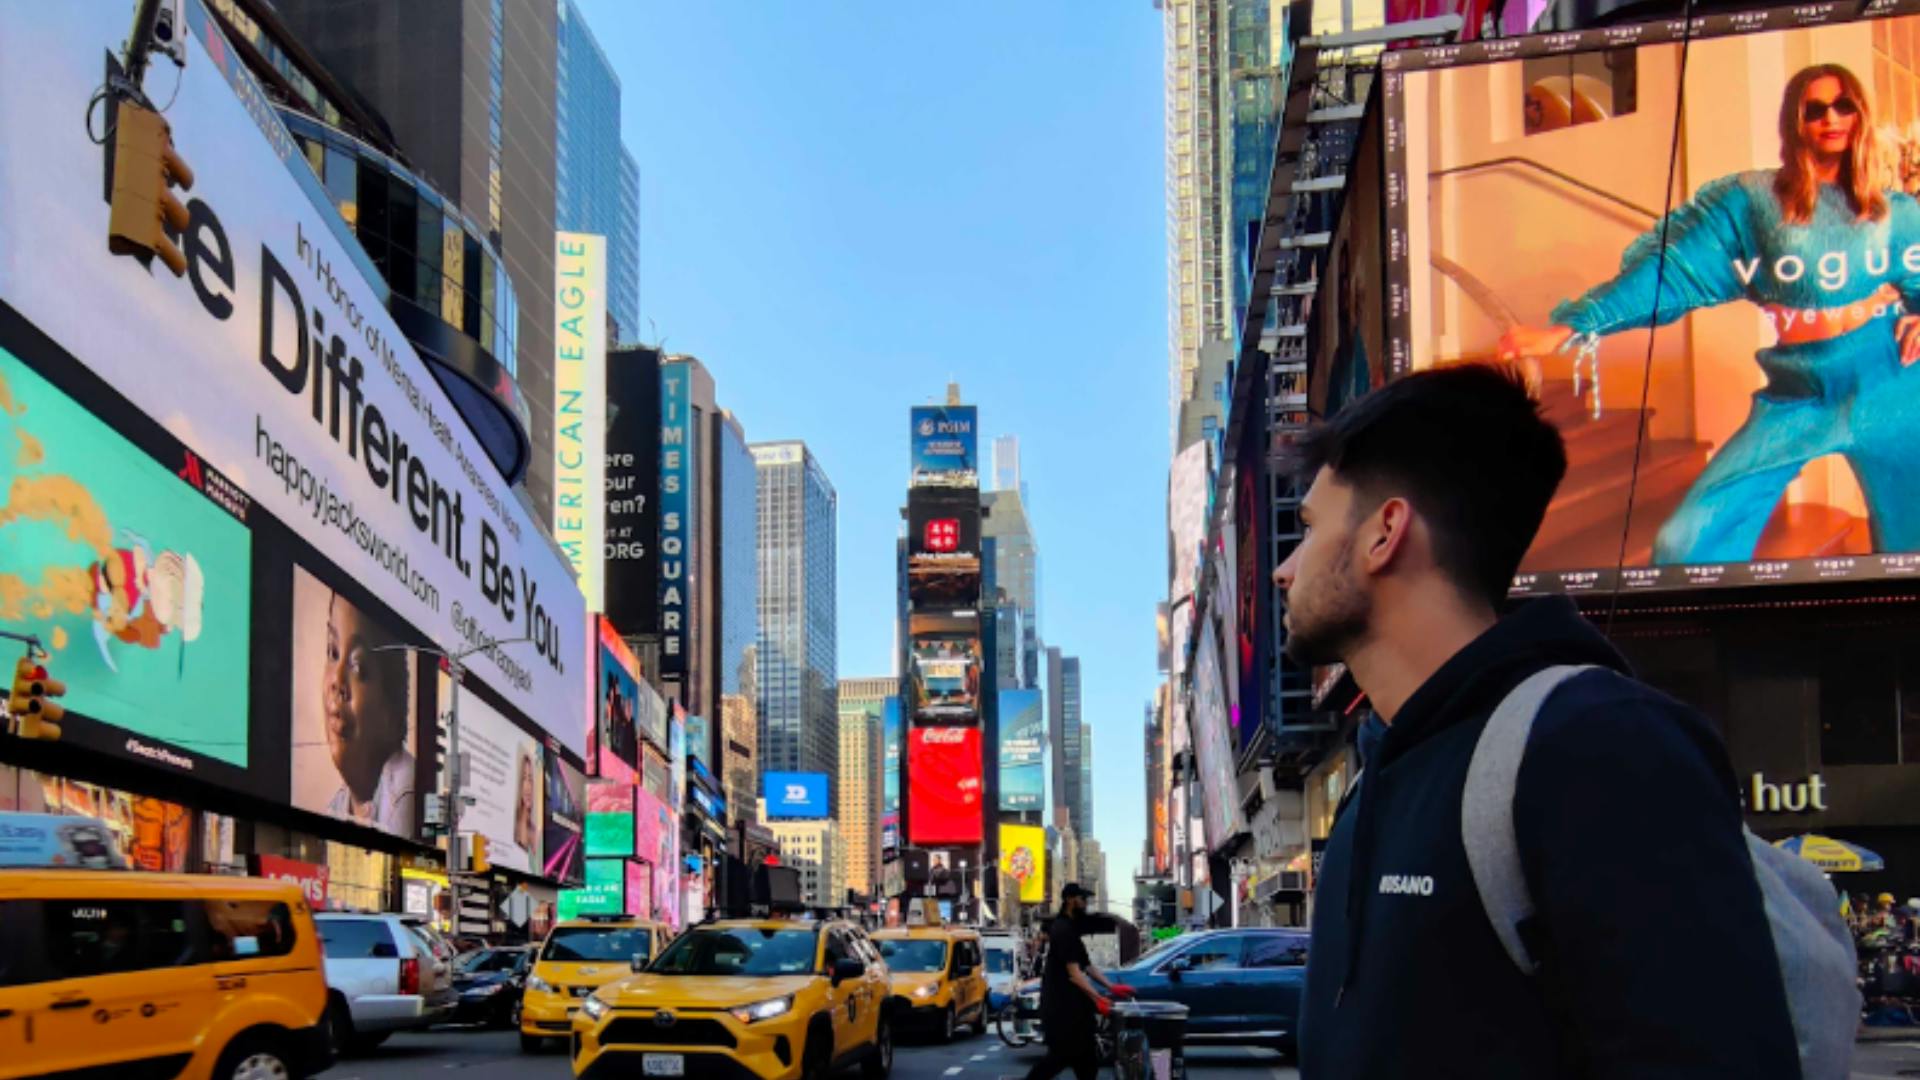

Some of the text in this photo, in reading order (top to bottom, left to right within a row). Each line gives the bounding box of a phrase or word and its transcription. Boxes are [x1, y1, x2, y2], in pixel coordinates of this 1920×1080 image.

[297, 221, 312, 270] In
[316, 248, 364, 334] Honor
[1732, 243, 1920, 291] vogue
[260, 241, 471, 580] Different.
[481, 518, 515, 623] Be
[520, 566, 563, 675] You.
[559, 240, 584, 572] MERICAN EAGLE
[256, 413, 440, 614] happyjacksworld.com
[605, 495, 646, 514] en?
[661, 378, 683, 655] TIMES SQUARE
[1753, 772, 1828, 811] hut
